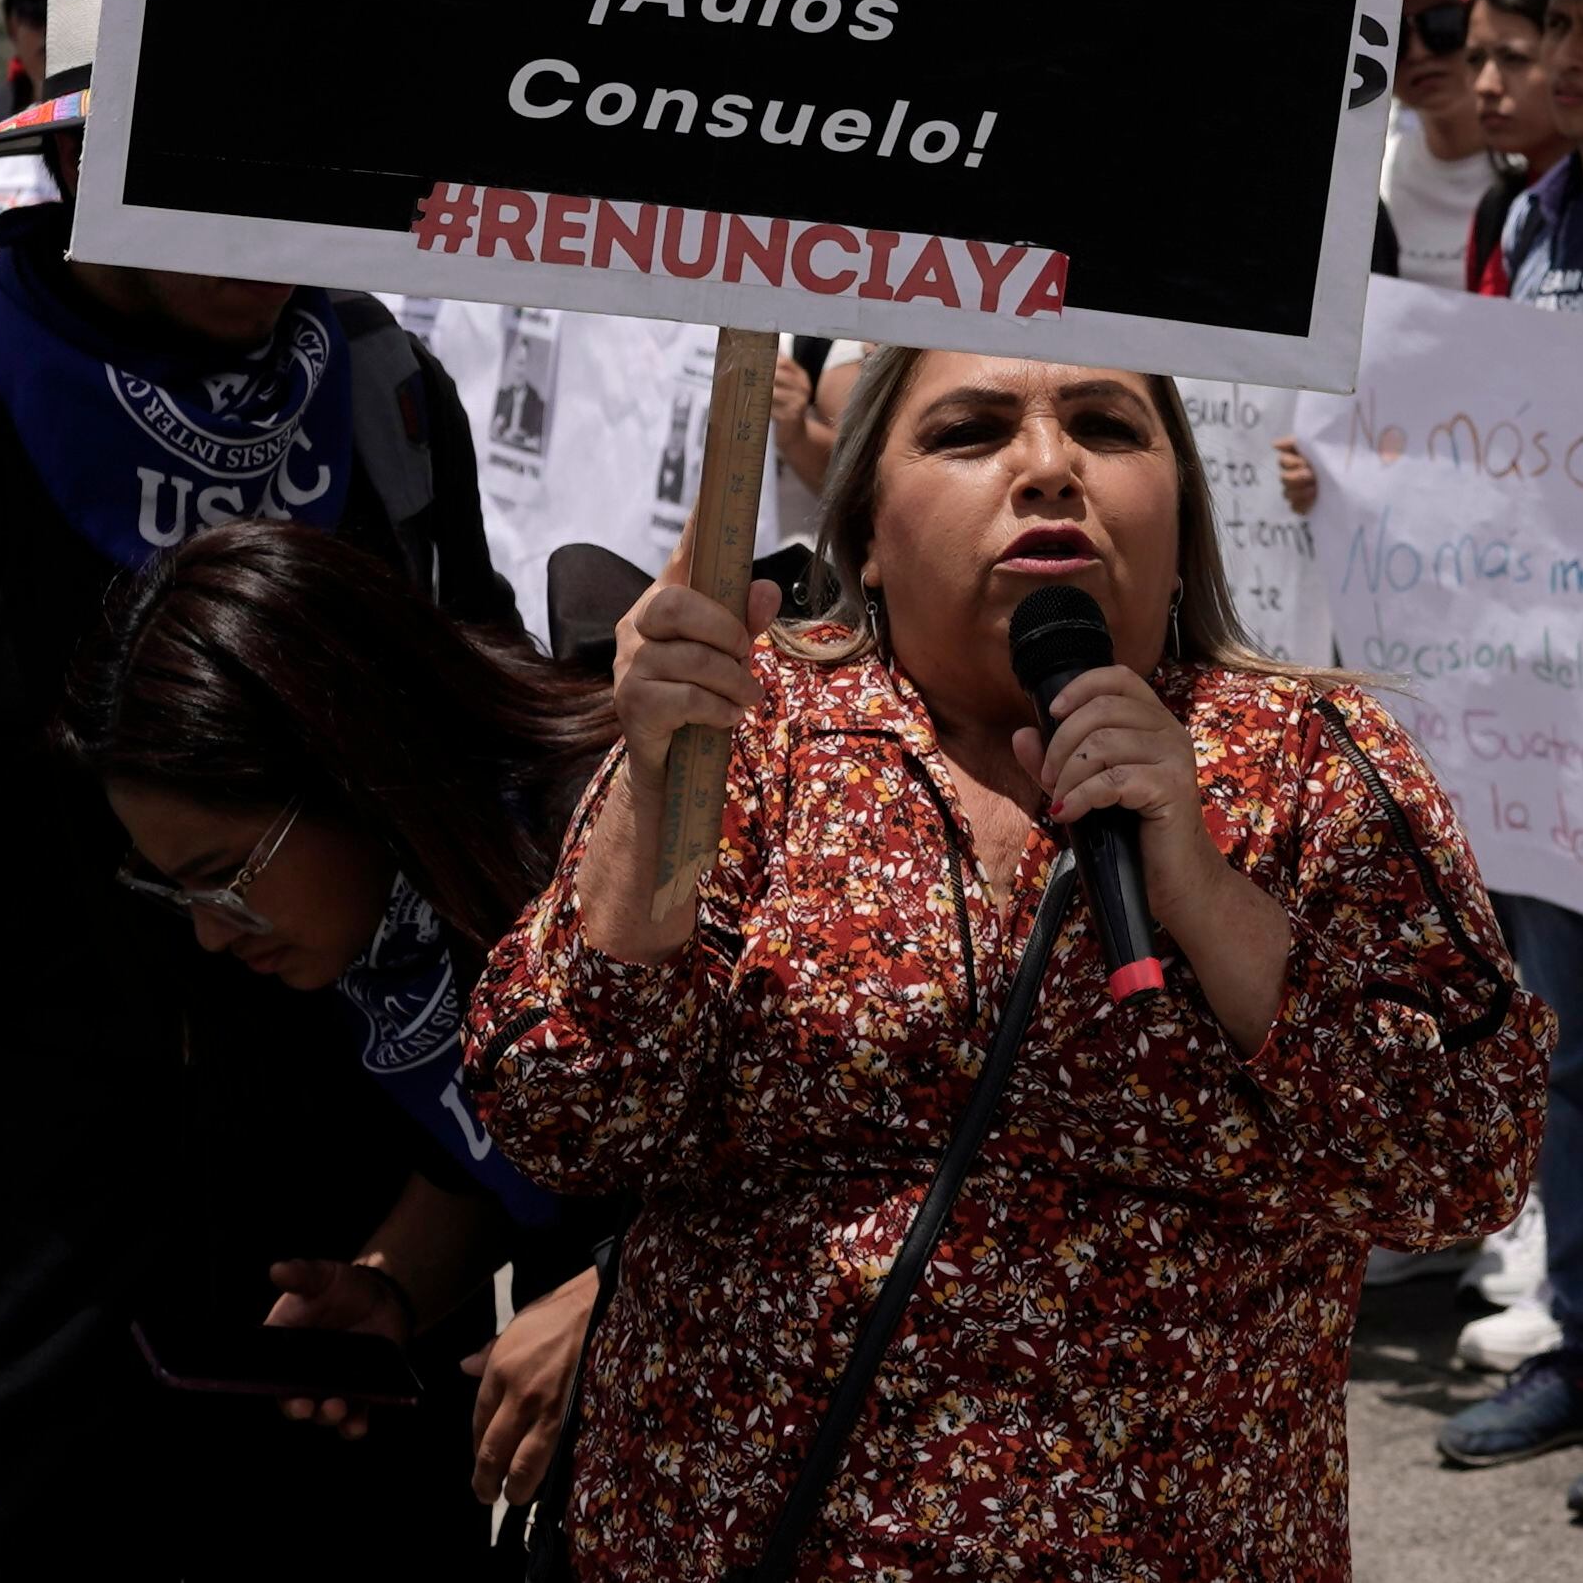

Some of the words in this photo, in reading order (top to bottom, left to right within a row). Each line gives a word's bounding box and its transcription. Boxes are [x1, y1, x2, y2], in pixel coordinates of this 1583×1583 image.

[506, 57, 999, 172] Consuelo!
[413, 182, 1068, 319] #RENUNCIAYA
[1346, 388, 1407, 473] No
[1427, 401, 1552, 481] más
[1342, 504, 1422, 595] No
[1432, 524, 1533, 586] más
